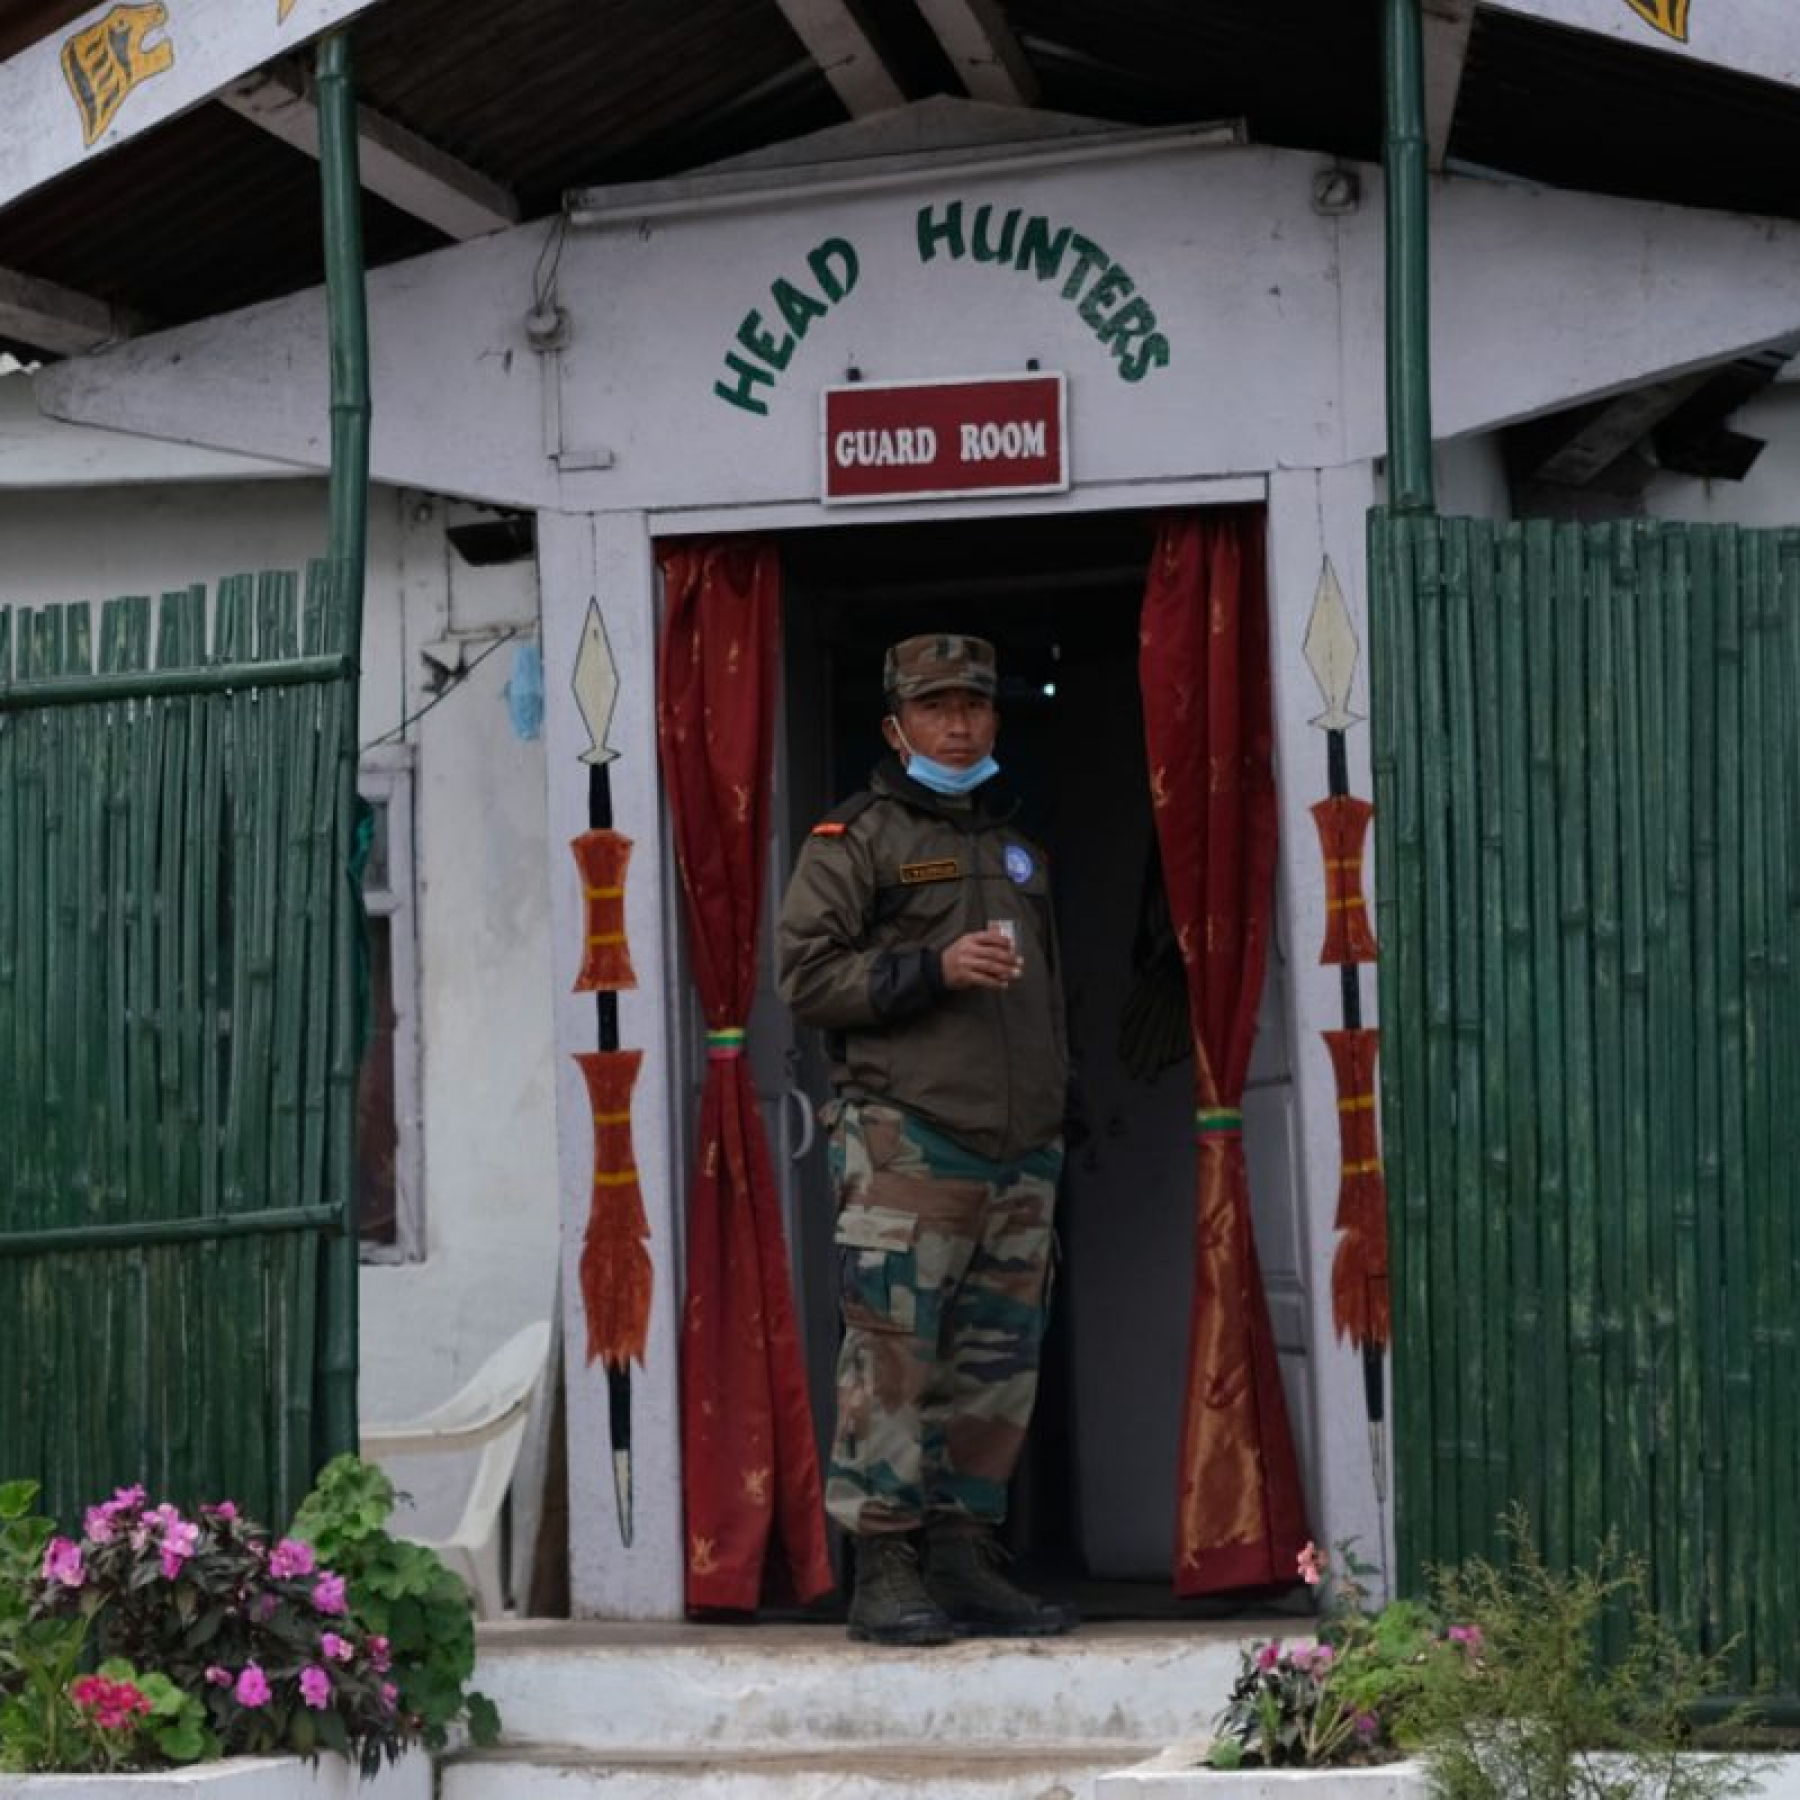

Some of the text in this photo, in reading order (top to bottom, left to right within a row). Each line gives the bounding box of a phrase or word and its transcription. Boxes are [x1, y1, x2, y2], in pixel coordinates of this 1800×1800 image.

[713, 200, 1170, 416] HEAD HUNTERS
[835, 420, 1046, 467] GUARD ROOM
